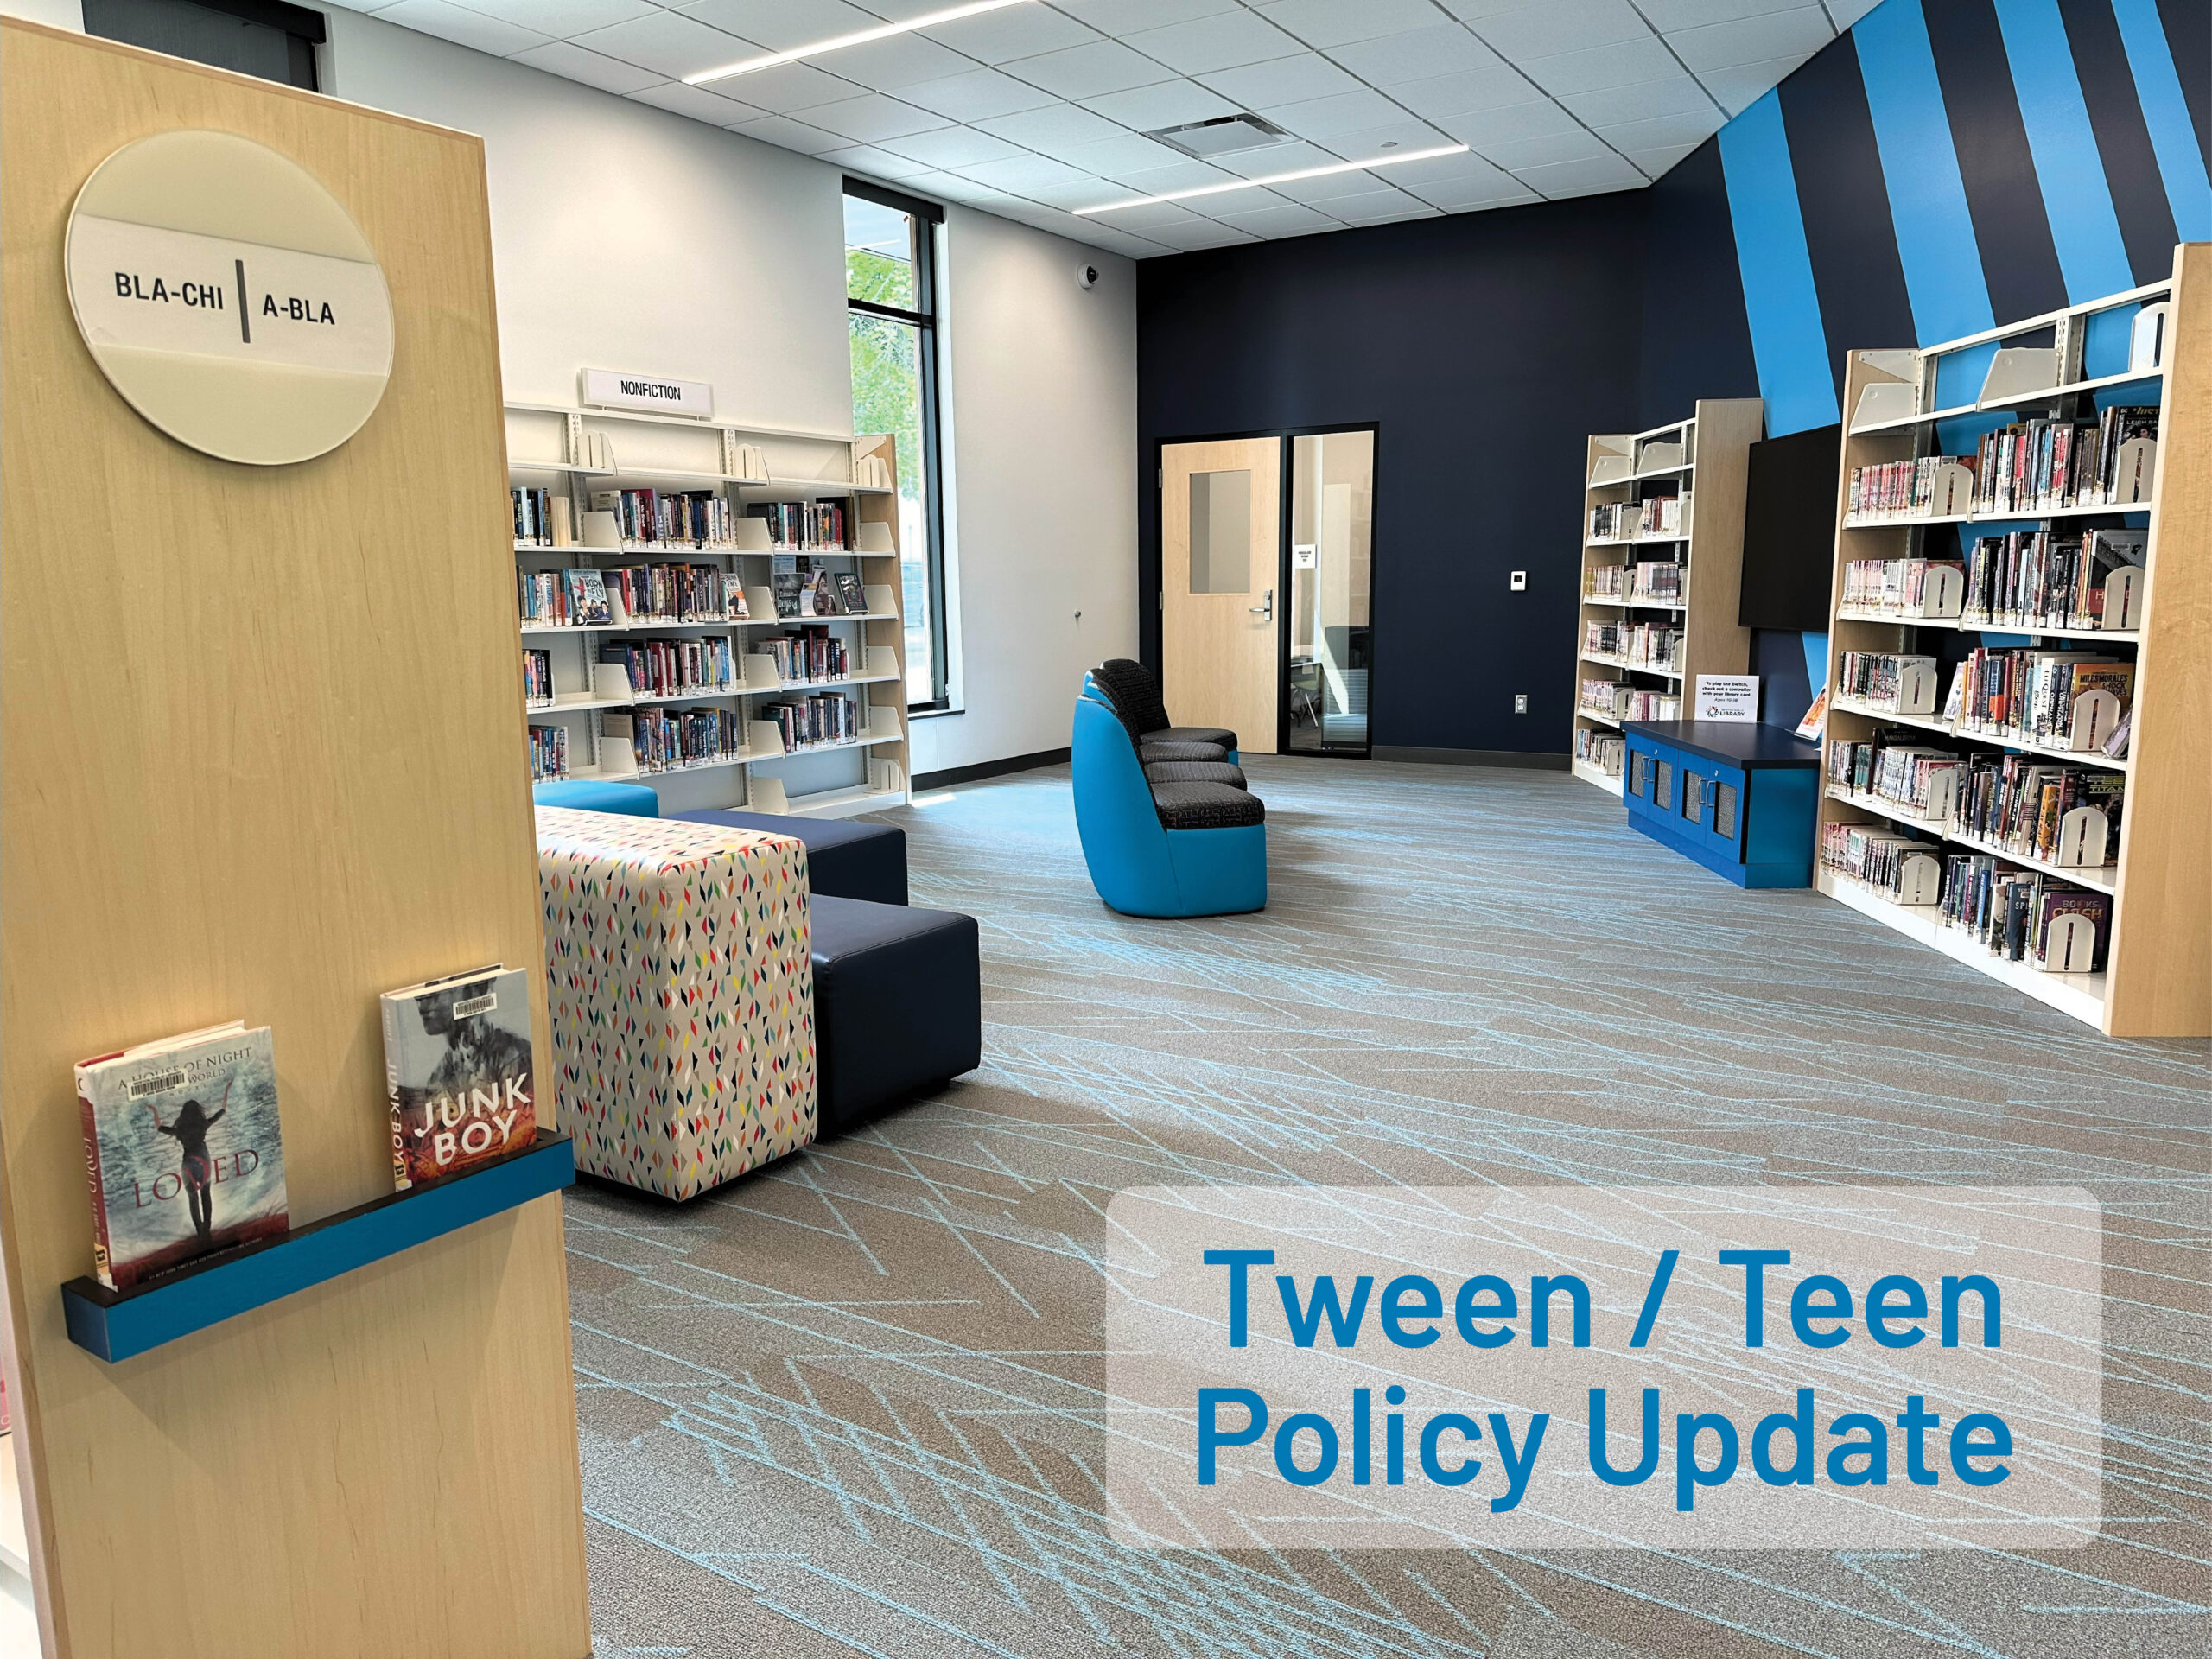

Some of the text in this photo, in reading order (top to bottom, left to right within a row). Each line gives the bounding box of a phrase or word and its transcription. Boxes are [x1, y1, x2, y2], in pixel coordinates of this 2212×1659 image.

[114, 271, 224, 310] BLA-CHI
[262, 294, 335, 325] A-BLA
[620, 380, 681, 400] NONFICTION
[2080, 674, 2128, 683] MILES MORALES
[184, 1059, 202, 1072] OF
[207, 1046, 251, 1067] NIGHT
[188, 1068, 226, 1084] WORLD
[387, 1058, 404, 1162] JUNK BOY
[414, 1072, 532, 1138] JUNK
[435, 1109, 518, 1166] BOY
[133, 1149, 260, 1208] LOVED
